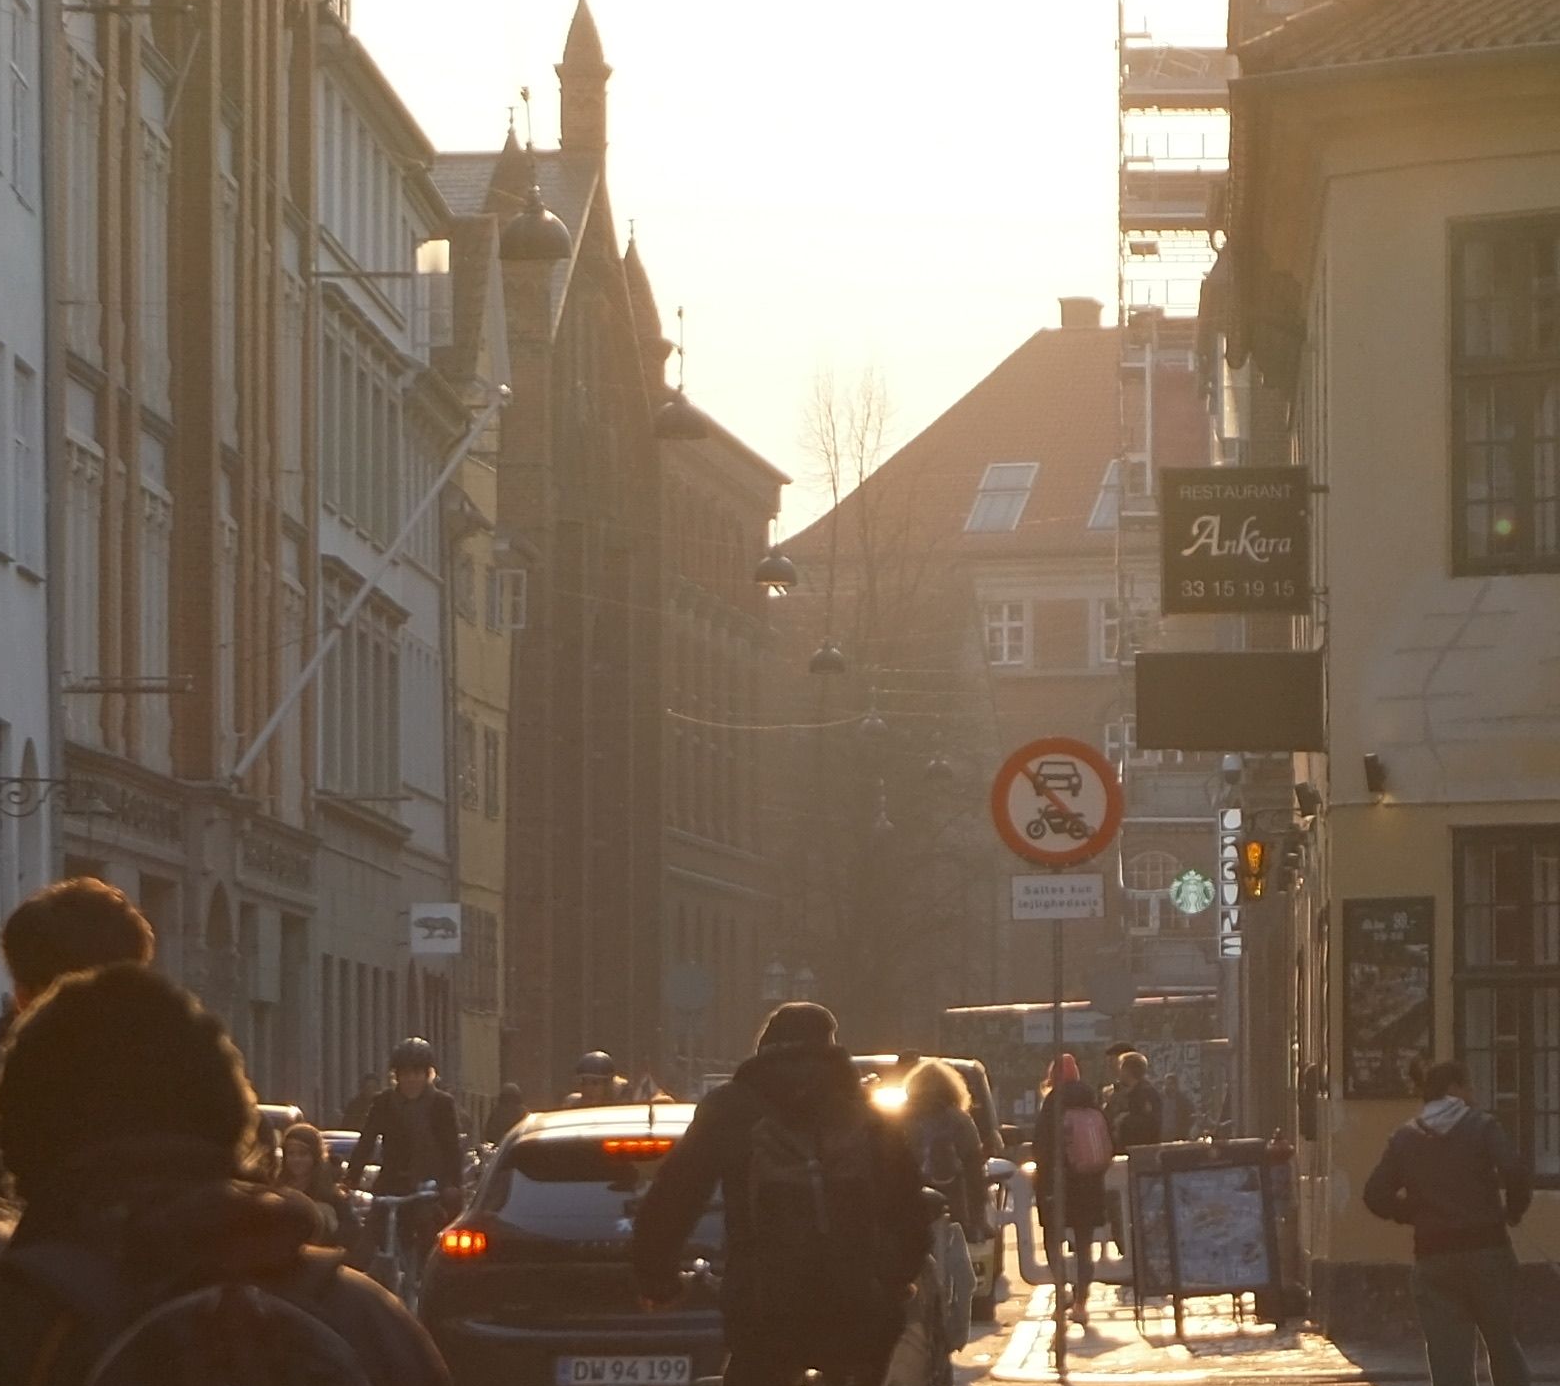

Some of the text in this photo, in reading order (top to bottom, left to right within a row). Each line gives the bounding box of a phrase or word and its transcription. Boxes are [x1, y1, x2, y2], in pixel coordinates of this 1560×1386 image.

[1180, 485, 1292, 501] RESTAURANT
[1181, 515, 1292, 562] Ankara
[1181, 580, 1295, 597] 33 15 19 15
[574, 1359, 687, 1381] DW 94 199
